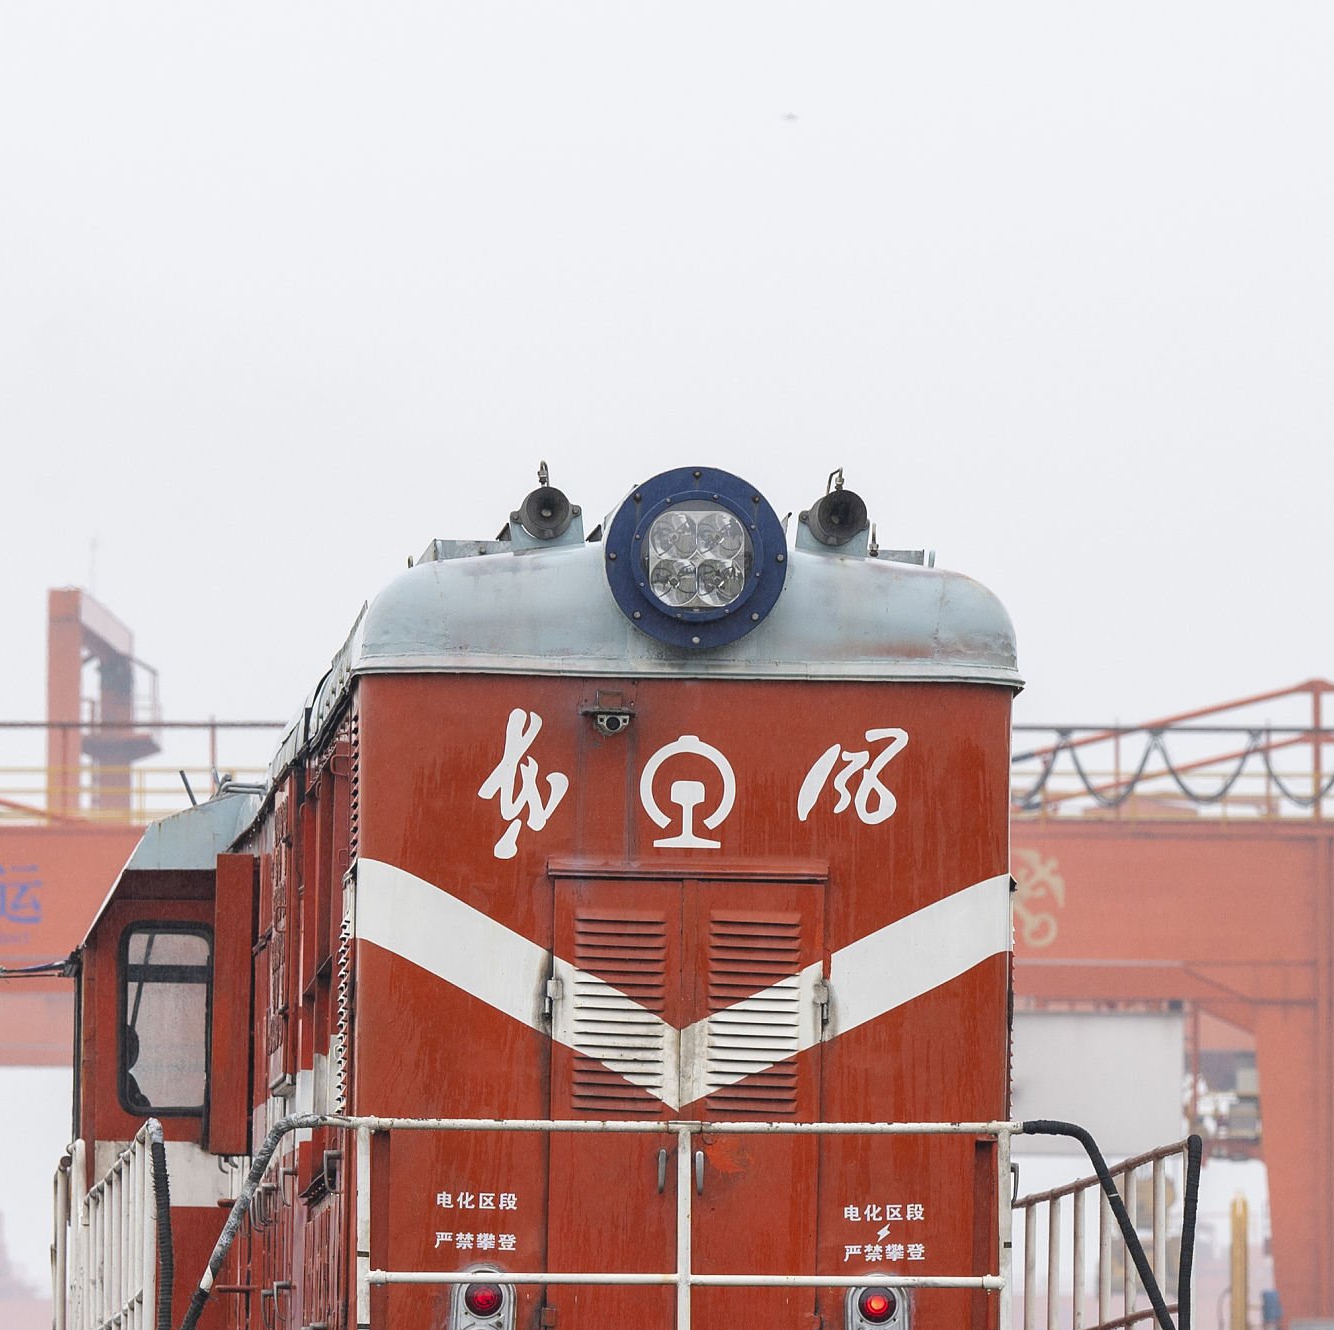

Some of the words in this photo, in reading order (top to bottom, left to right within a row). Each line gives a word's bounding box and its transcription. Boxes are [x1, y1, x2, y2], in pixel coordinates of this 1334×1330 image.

[436, 1191, 518, 1210] 电化区段
[844, 1203, 925, 1222] 电化区段
[434, 1232, 517, 1251] 严禁攀登
[844, 1243, 925, 1262] 严禁攀登
